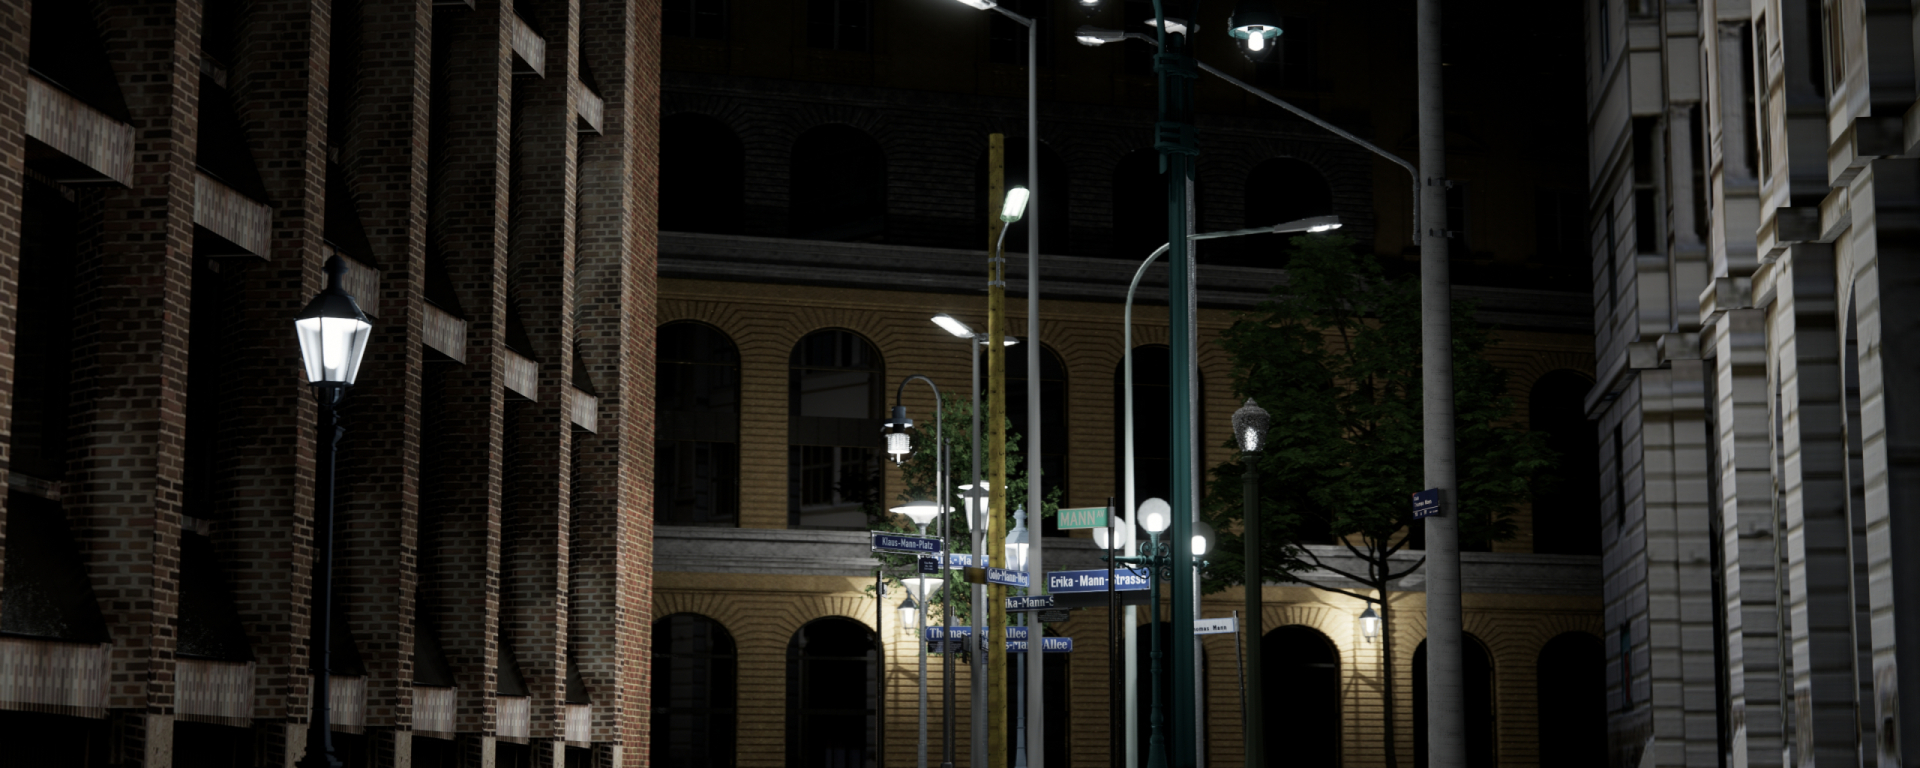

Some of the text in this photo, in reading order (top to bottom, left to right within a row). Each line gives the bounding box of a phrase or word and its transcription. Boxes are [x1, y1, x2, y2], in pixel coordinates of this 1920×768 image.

[1060, 509, 1105, 527] MANN AV
[881, 537, 934, 550] Klaus-Mann-Platz
[988, 568, 1028, 586] Golo-Mann-Weg
